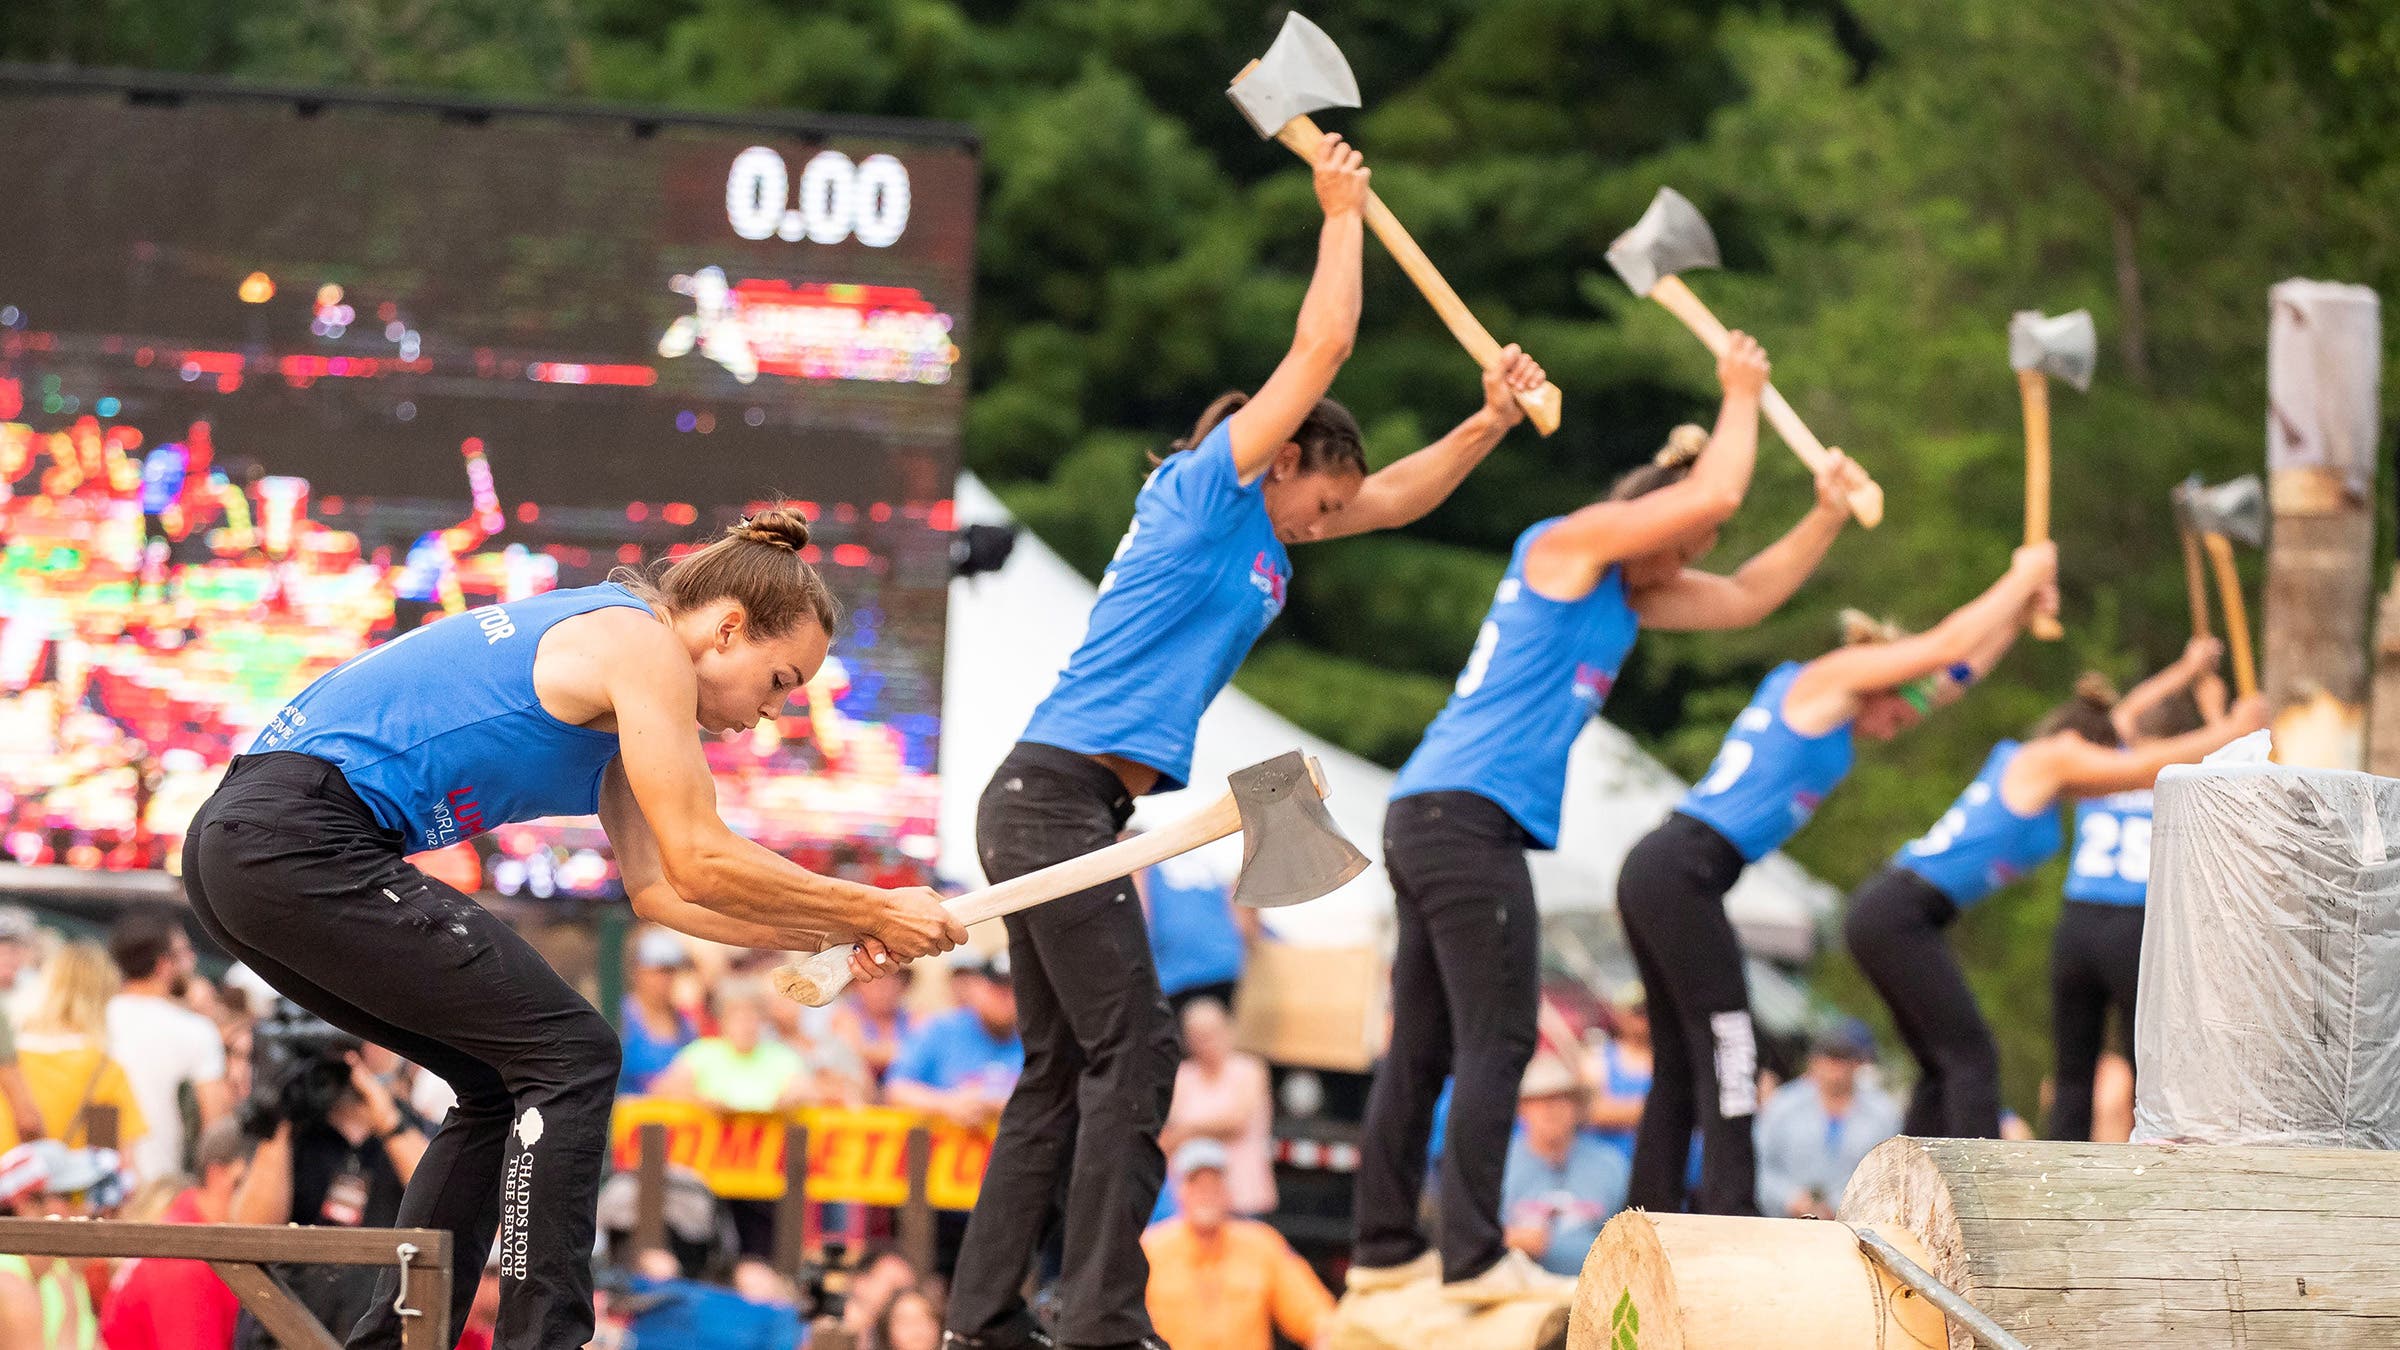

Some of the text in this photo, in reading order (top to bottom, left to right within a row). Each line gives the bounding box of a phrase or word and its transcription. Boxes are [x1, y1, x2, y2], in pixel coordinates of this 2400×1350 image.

[726, 146, 911, 247] 0.00
[425, 828, 439, 849] 202
[501, 1155, 520, 1277] TREE SERVICE
[514, 1152, 534, 1281] CHADDS FORD
